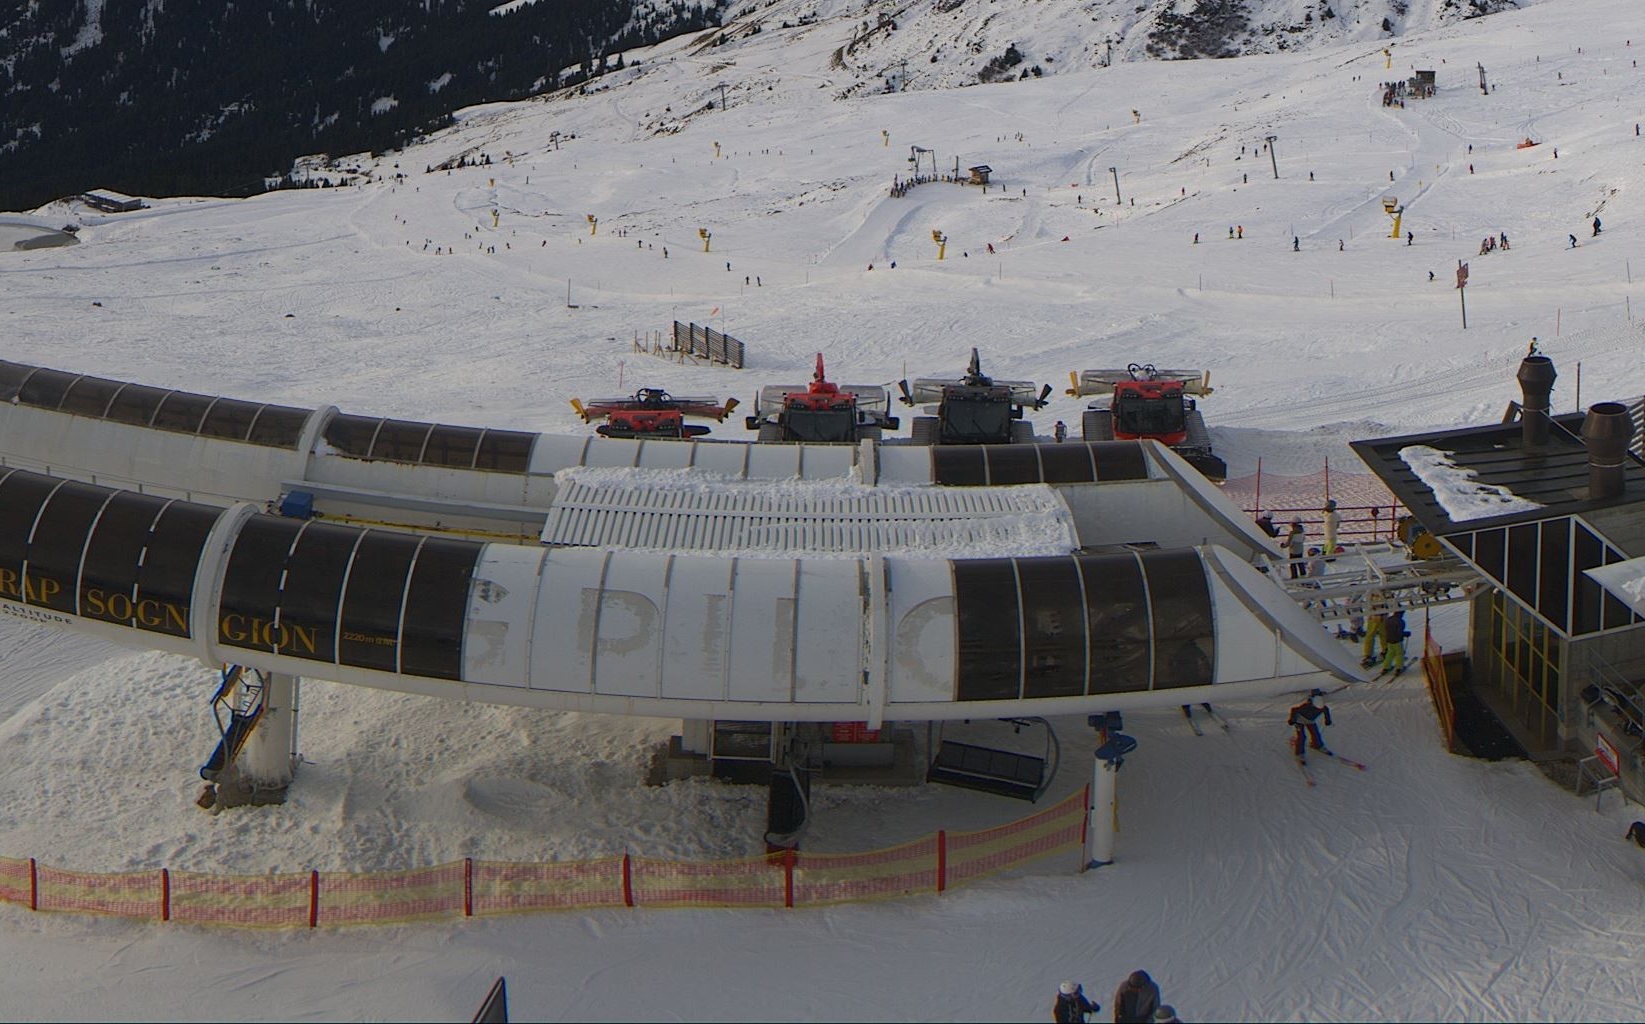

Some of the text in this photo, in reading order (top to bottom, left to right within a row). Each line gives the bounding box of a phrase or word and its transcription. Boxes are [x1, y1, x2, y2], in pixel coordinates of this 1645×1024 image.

[2, 603, 73, 625] ALTITUDE
[86, 588, 189, 633] SOGN
[220, 614, 317, 654] GION
